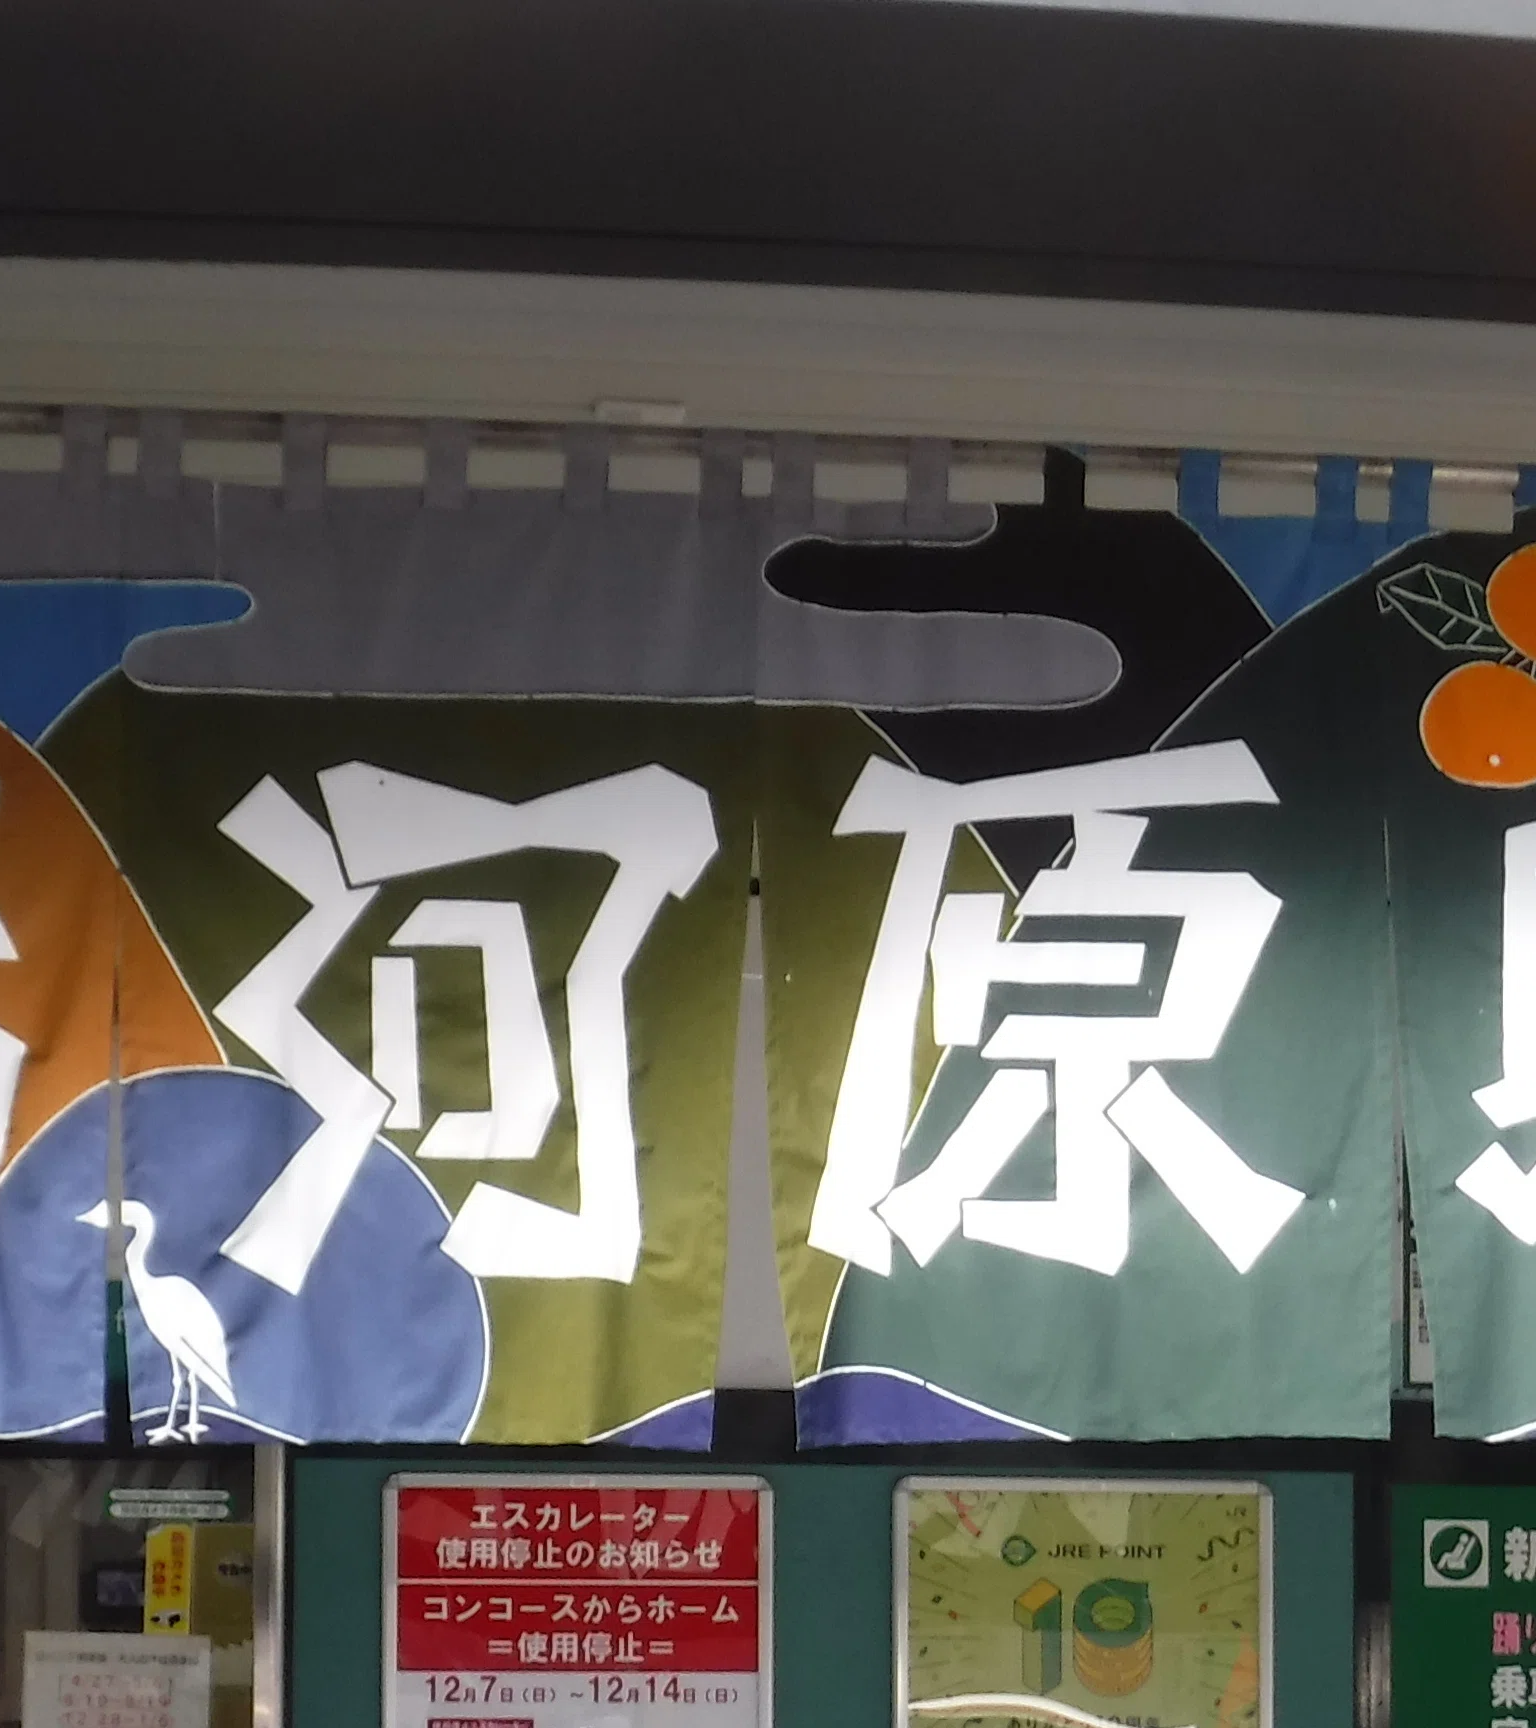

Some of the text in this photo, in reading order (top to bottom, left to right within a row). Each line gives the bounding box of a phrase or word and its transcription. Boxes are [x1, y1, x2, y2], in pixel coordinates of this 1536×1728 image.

[470, 1503, 690, 1532] エスカレーター
[437, 1537, 722, 1570] 使用停止のお知らせ
[424, 1594, 739, 1623] コンコースからホーム
